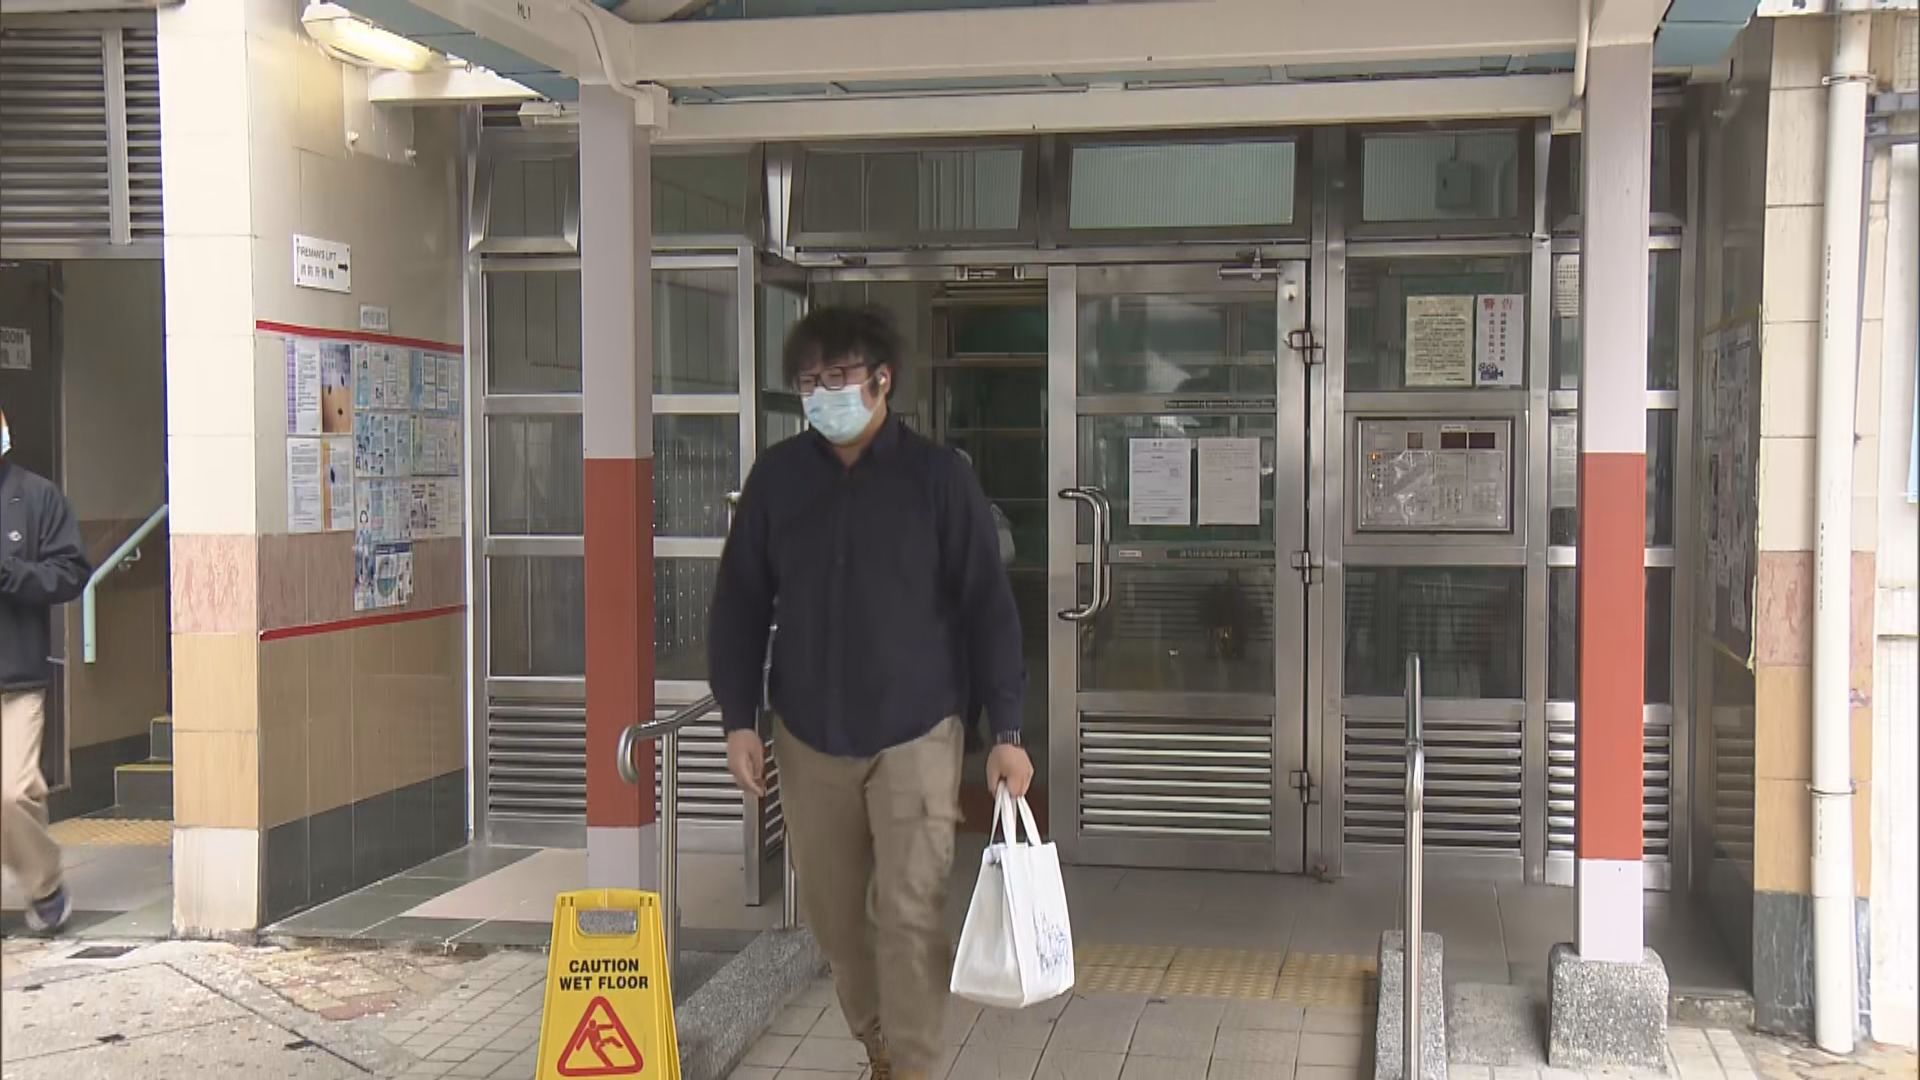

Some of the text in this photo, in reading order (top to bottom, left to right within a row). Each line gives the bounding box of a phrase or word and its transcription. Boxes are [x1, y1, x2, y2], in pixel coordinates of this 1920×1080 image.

[325, 252, 337, 261] LIFT
[569, 959, 639, 973] CAUTION
[560, 976, 648, 991] WET FLOOR
